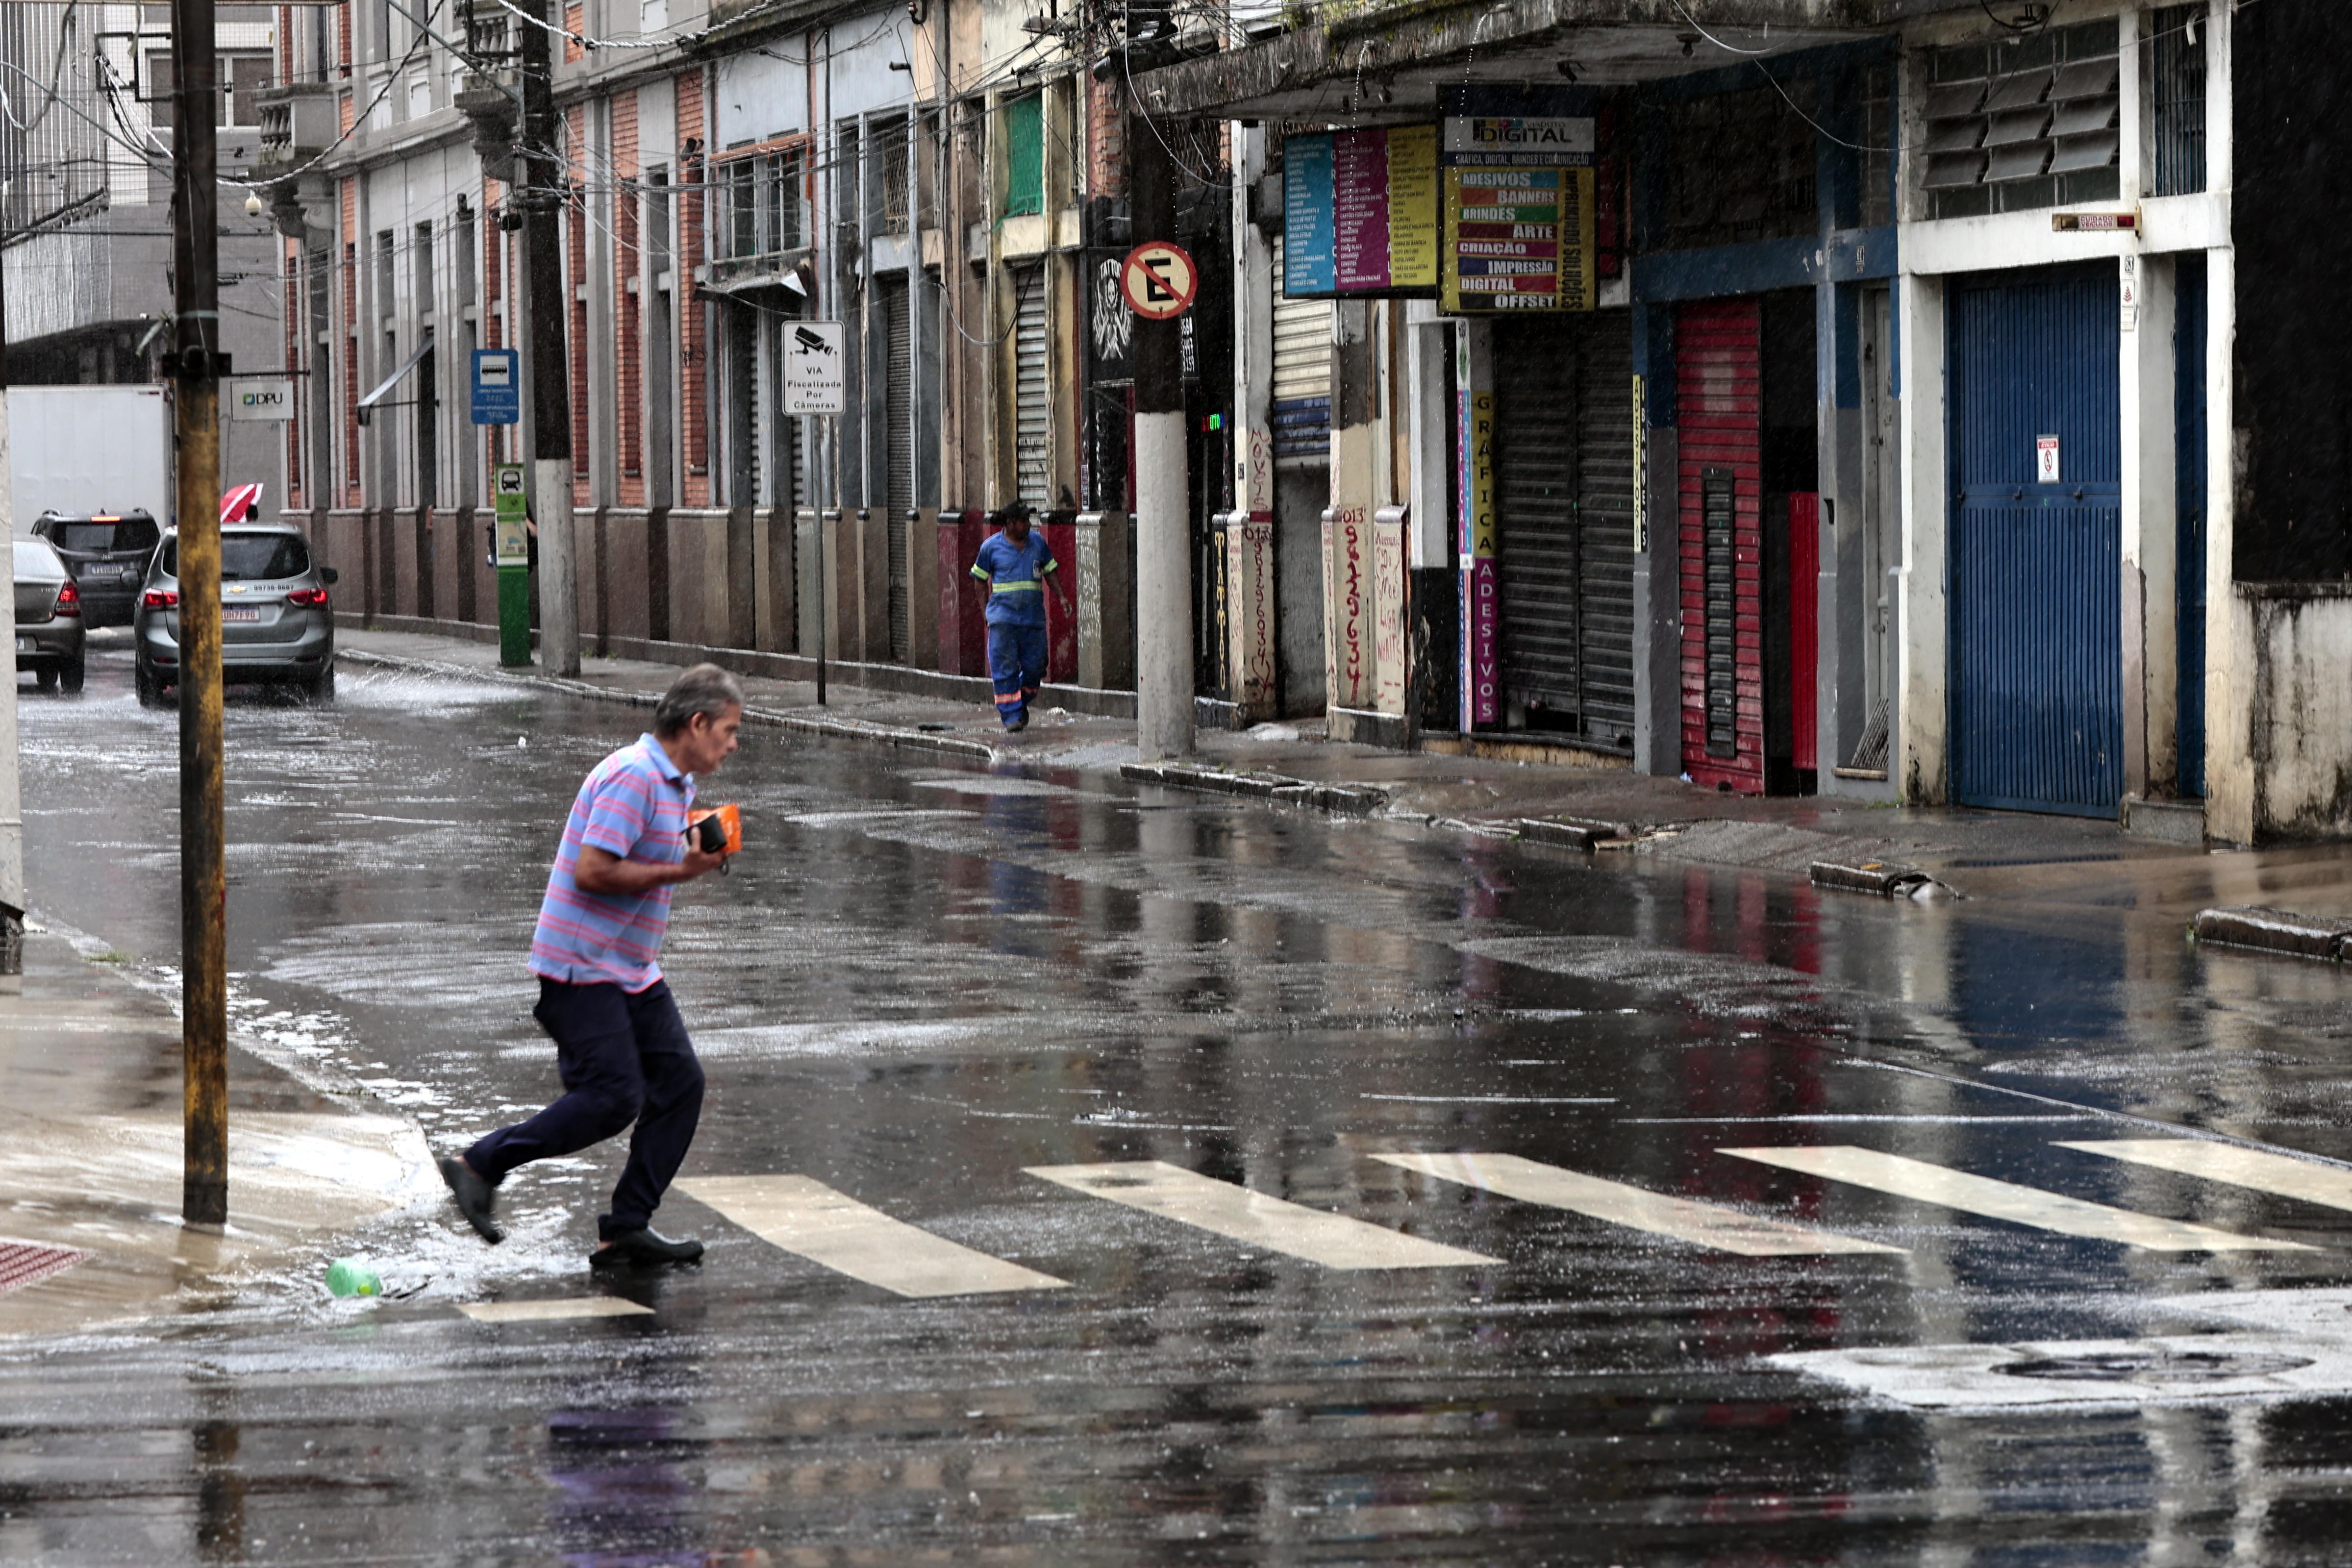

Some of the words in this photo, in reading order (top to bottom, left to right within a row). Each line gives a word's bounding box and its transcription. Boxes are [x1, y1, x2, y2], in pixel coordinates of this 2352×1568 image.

[1479, 126, 1572, 143] DIGITAL
[1456, 152, 1483, 166] GRÁFICA,
[1485, 153, 1509, 165] DIGITAL,
[1512, 153, 1538, 165] BRINDES
[1540, 153, 1543, 164] E
[1545, 152, 1589, 166] COMUNICAÇÃO
[1463, 172, 1531, 186] ADESIVOS
[1497, 189, 1555, 204] BANNERS
[1463, 206, 1516, 221] BRINDES
[1513, 224, 1553, 239] ARTE
[1459, 241, 1526, 255] CRIAÇÃO
[1488, 260, 1553, 274] IMPRESSÃO
[1461, 277, 1516, 291] DIGITAL
[1561, 249, 1586, 309] SOLUÇÕES
[1495, 294, 1554, 308] OFFSET
[806, 366, 823, 374] VIA
[256, 392, 283, 404] DPU
[794, 400, 835, 409] Câmeras
[1343, 507, 1364, 523] 013
[1480, 563, 1494, 718] ADESIVOS
